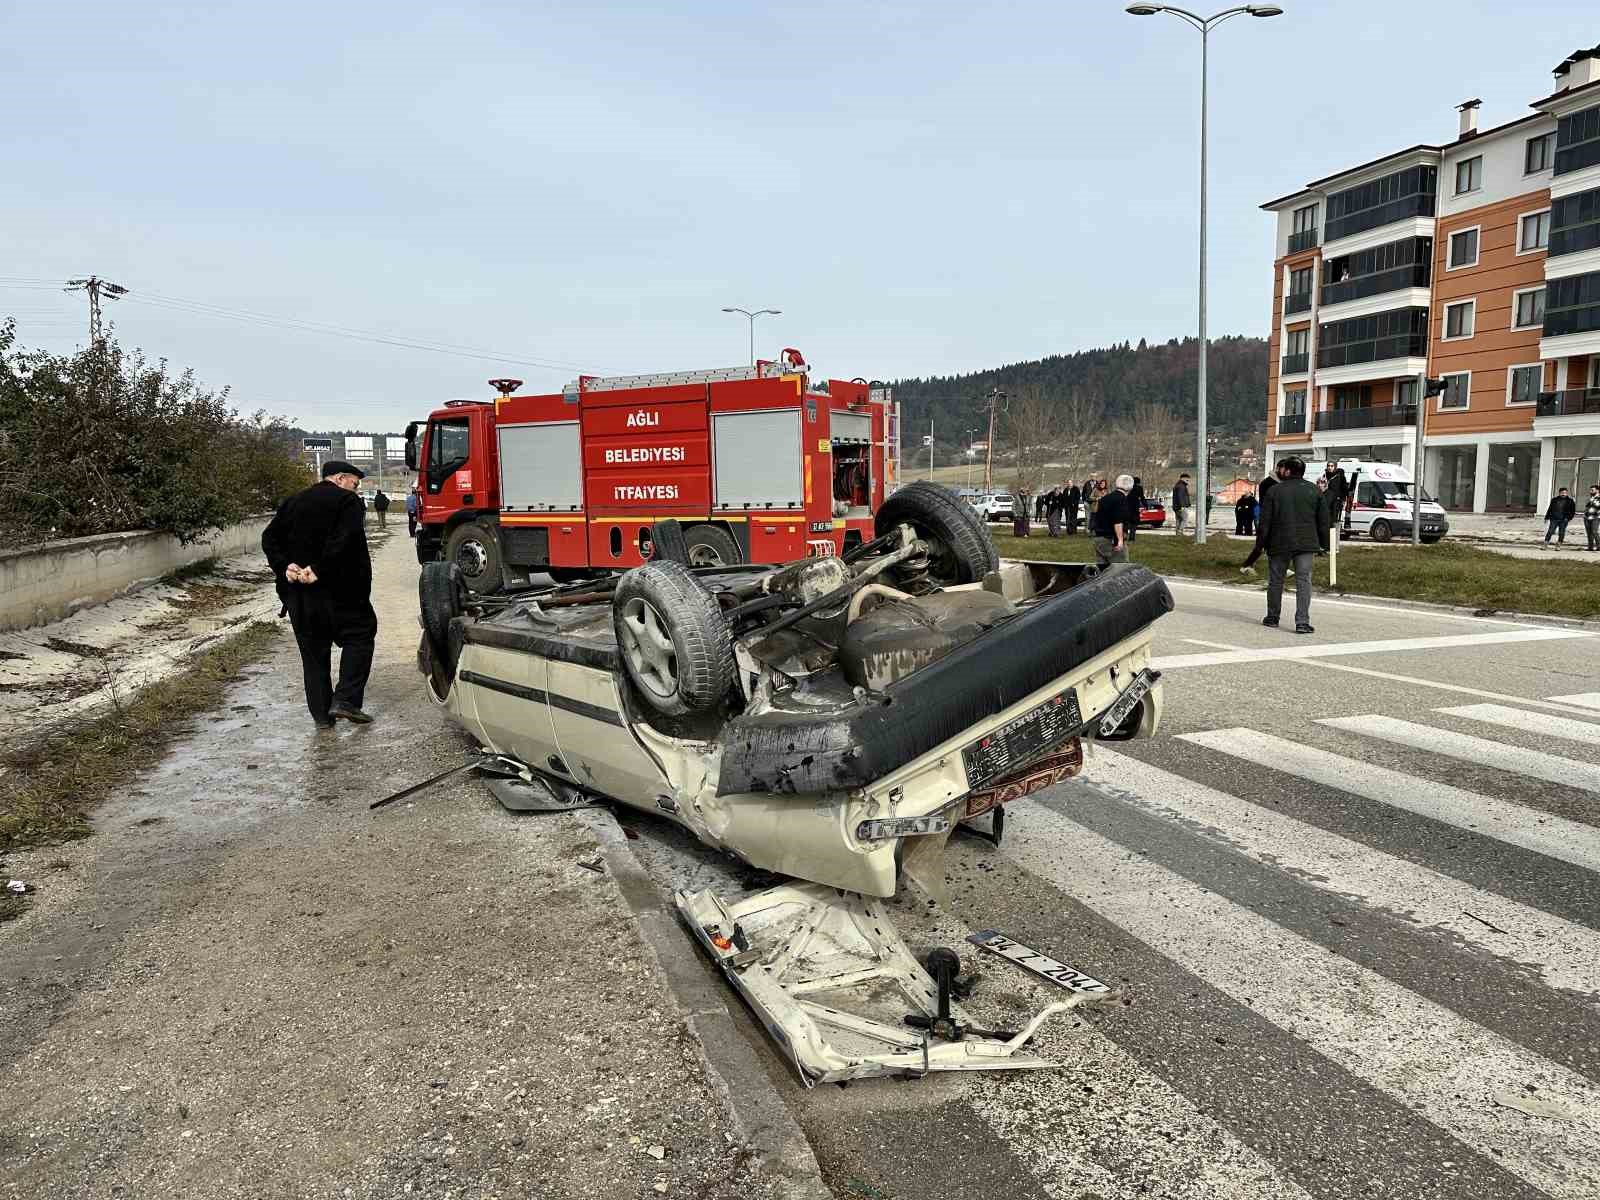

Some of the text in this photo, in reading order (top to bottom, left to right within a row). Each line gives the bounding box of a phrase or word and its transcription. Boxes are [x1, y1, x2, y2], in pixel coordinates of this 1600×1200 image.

[626, 410, 659, 427] AĞLI
[605, 447, 685, 463] BELEDİYESİ
[614, 485, 679, 500] İTFAİYESİ
[986, 937, 1016, 951] 34
[1016, 952, 1040, 963] Z
